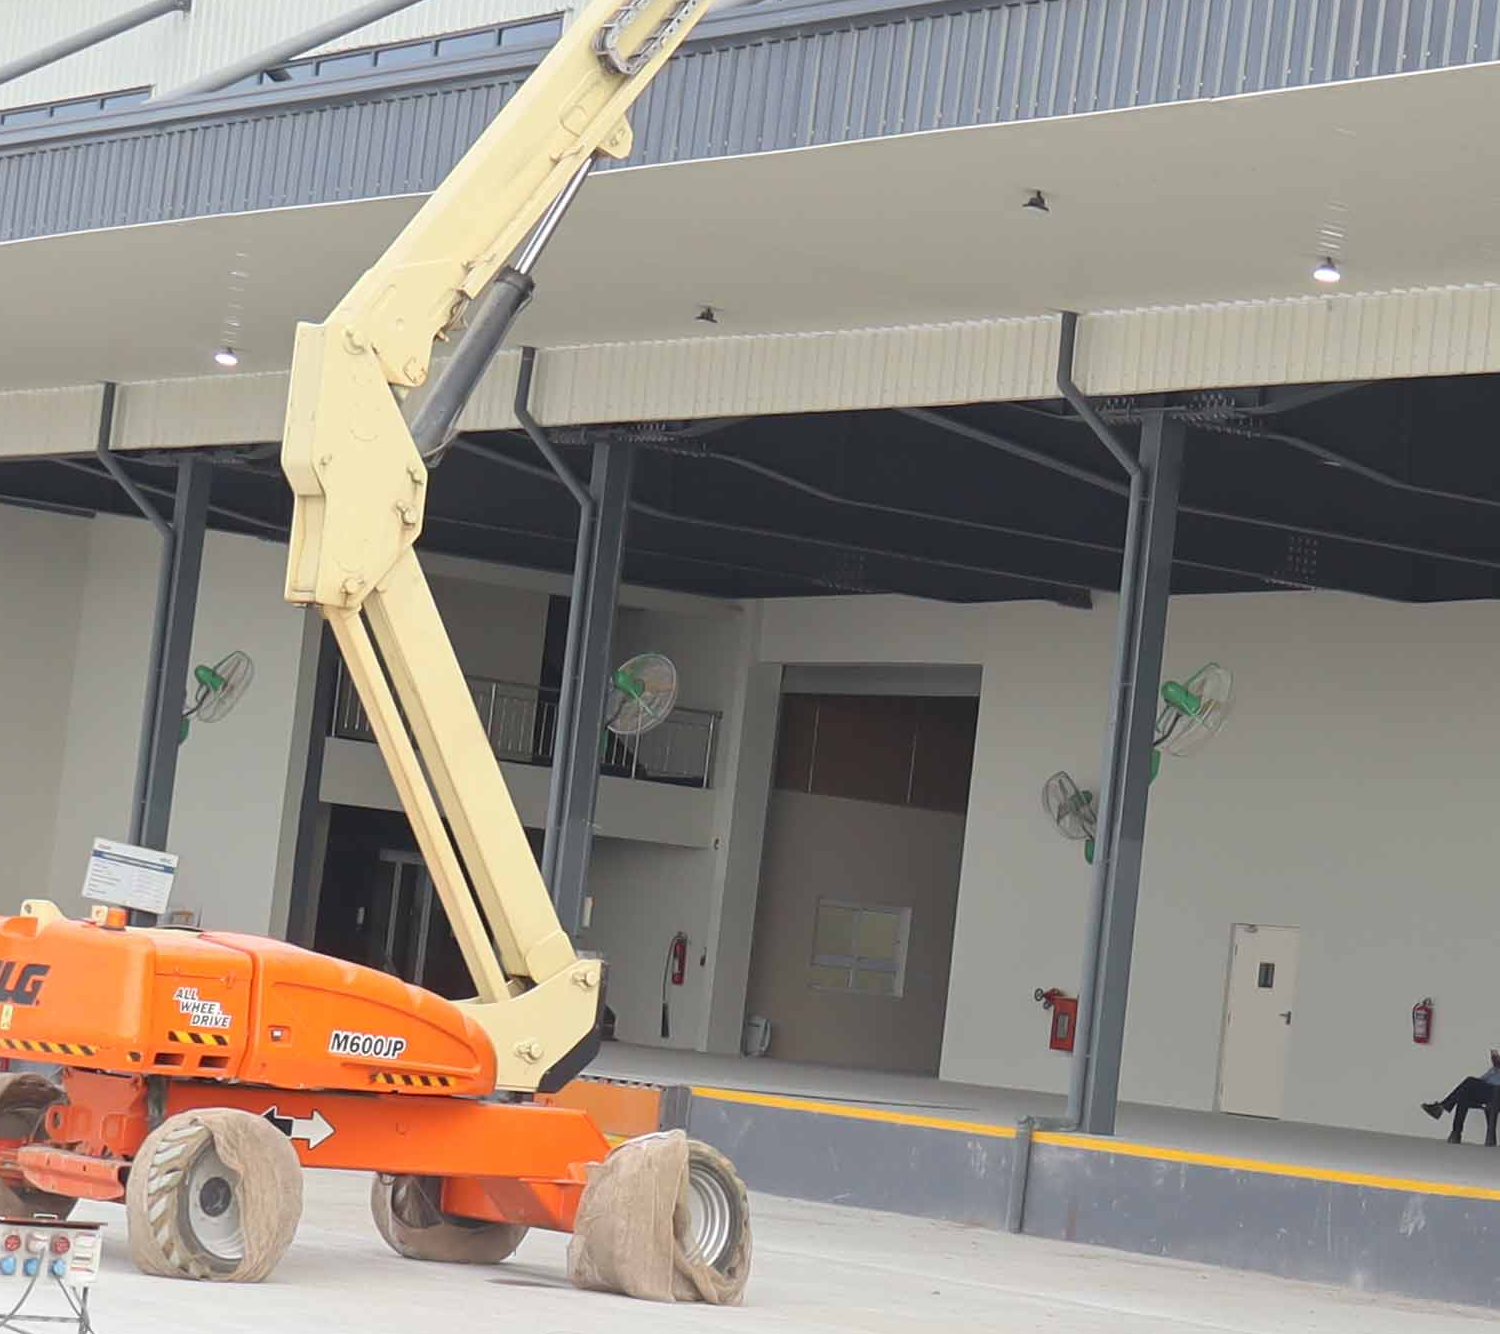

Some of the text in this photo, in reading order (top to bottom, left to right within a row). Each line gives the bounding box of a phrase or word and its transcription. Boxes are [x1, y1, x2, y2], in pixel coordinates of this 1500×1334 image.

[175, 988, 198, 1001] ALL
[180, 1000, 223, 1015] WHEE
[191, 1014, 230, 1028] DRIVE
[330, 1032, 405, 1057] M600JP
